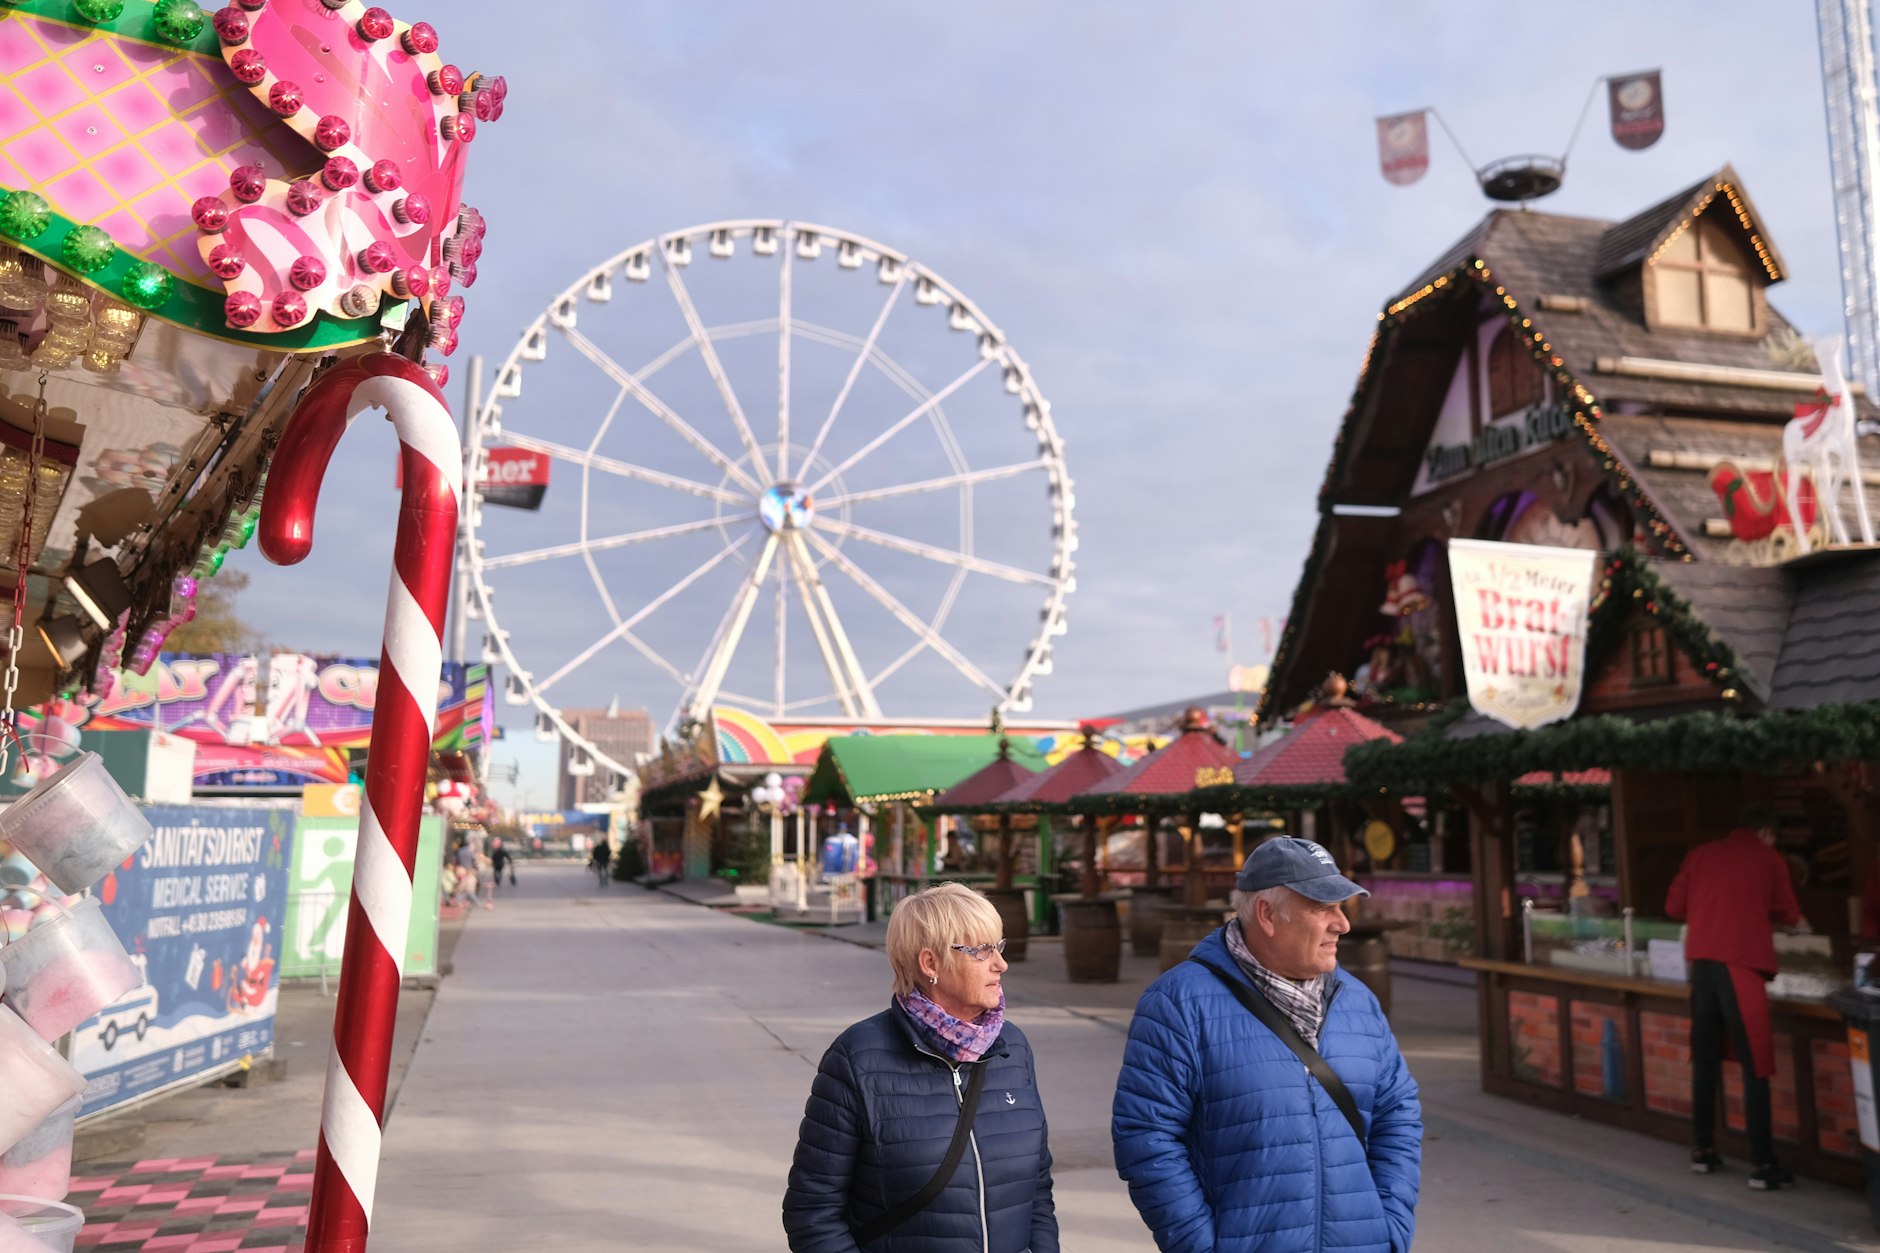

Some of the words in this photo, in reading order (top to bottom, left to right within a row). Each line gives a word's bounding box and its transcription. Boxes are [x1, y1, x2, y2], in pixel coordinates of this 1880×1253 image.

[141, 817, 265, 869] SANITÄTSDIENST
[152, 875, 203, 909] MEDICAL
[204, 871, 249, 904] SERVICE
